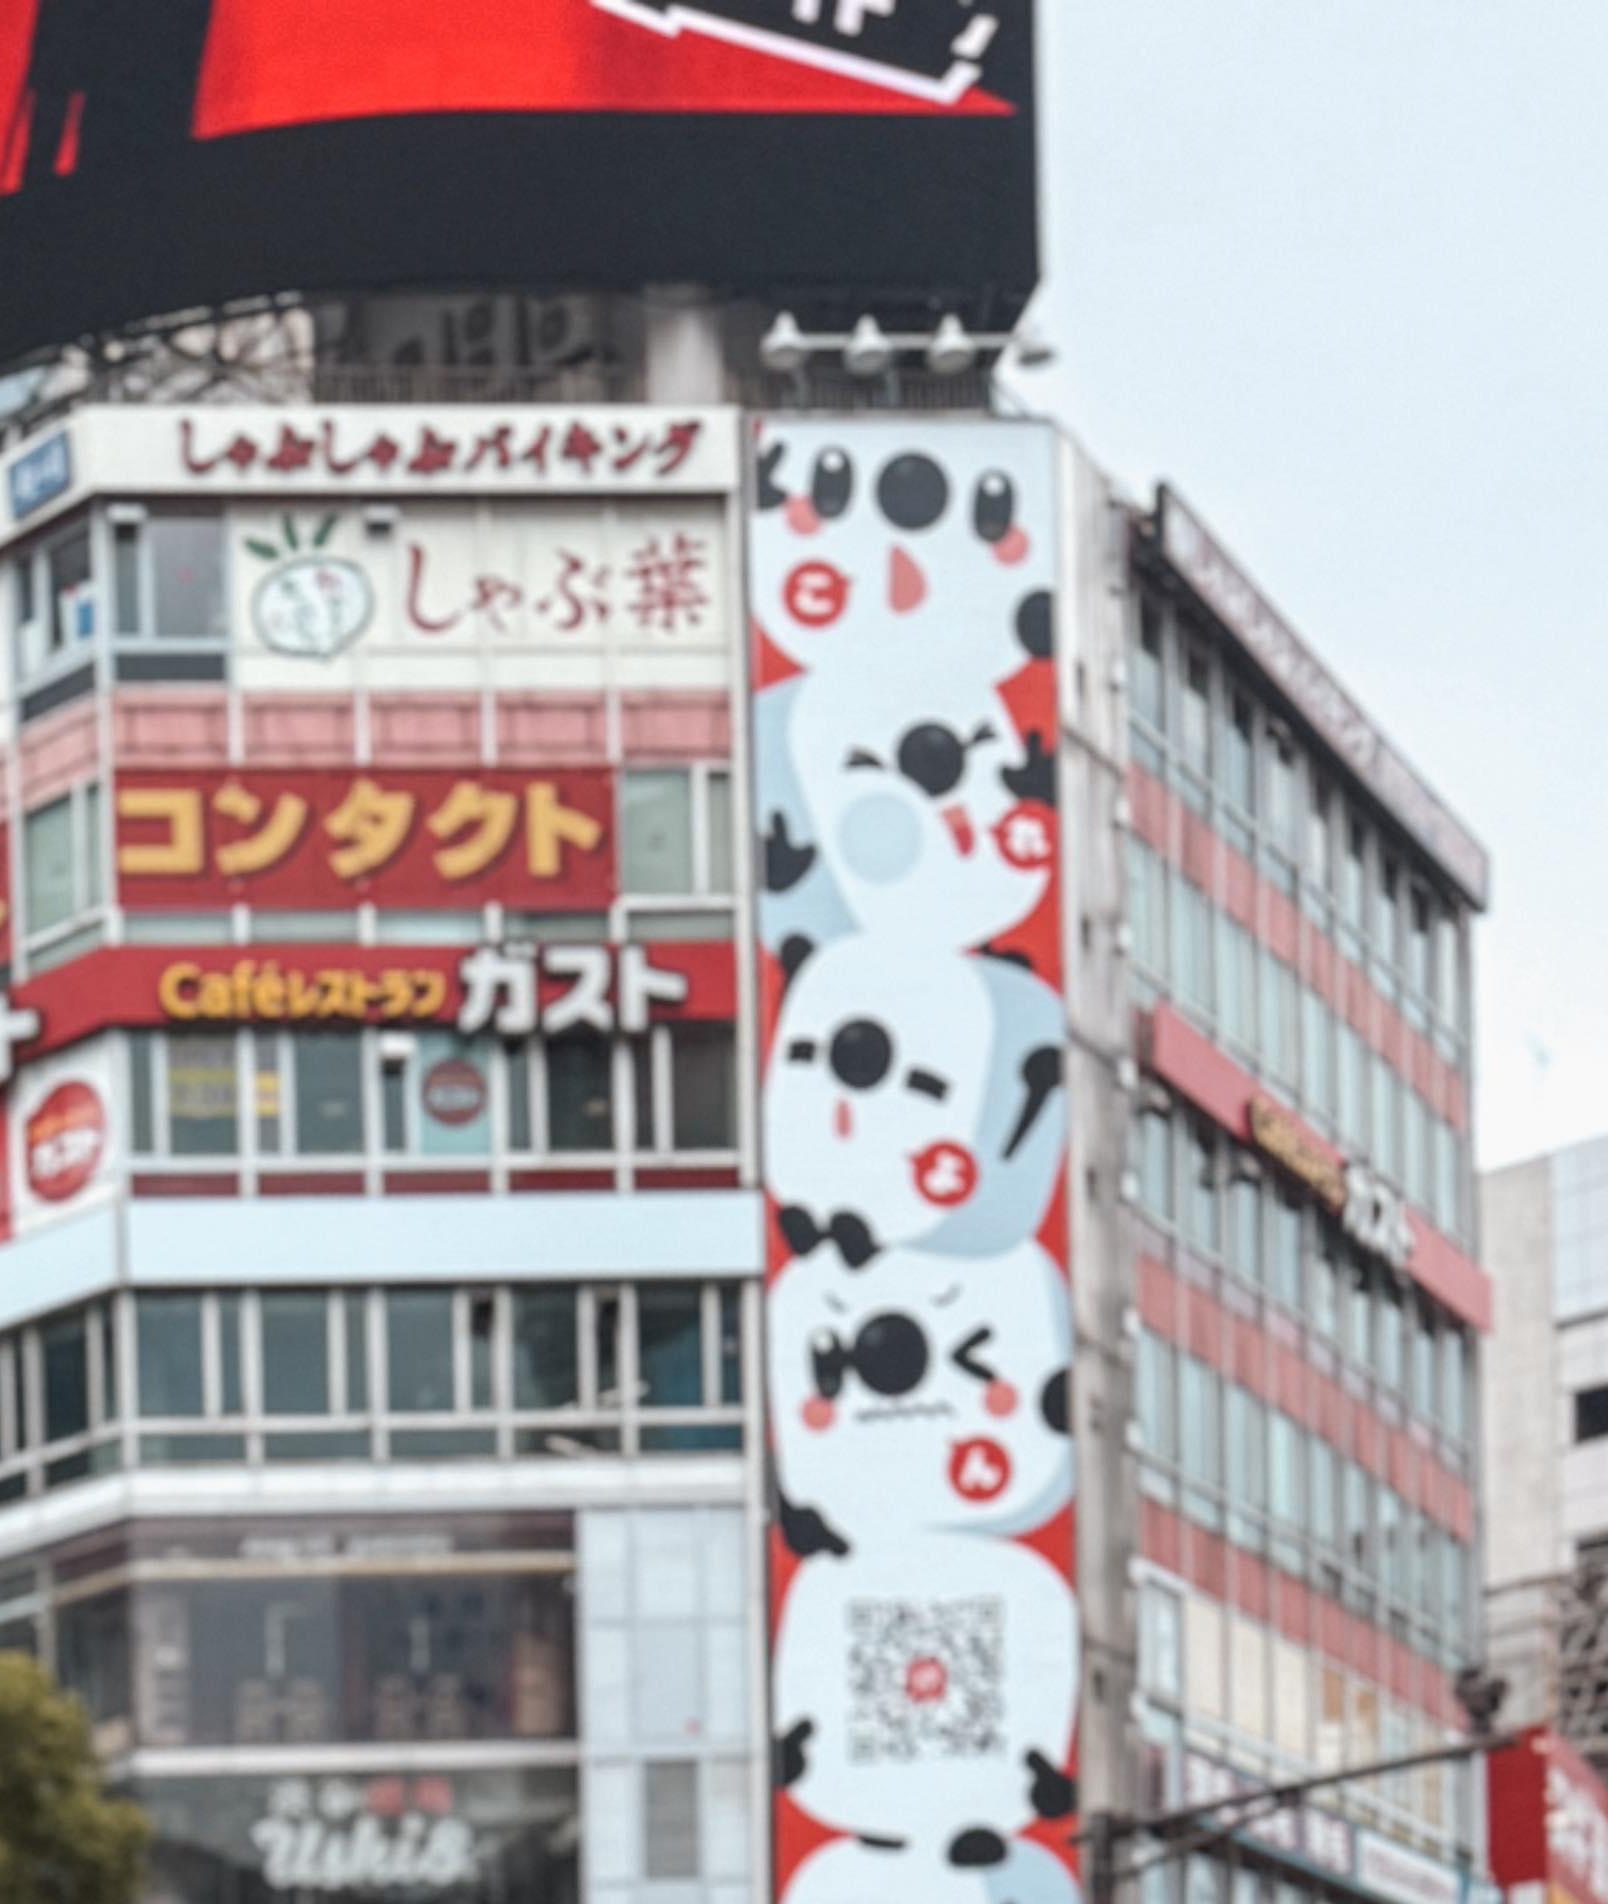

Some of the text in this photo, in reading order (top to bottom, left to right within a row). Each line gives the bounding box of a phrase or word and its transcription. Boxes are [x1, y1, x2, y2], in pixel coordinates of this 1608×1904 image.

[404, 530, 710, 638] しゃぶ葉
[116, 779, 604, 880] コンタクト
[458, 943, 689, 1037] ガスト
